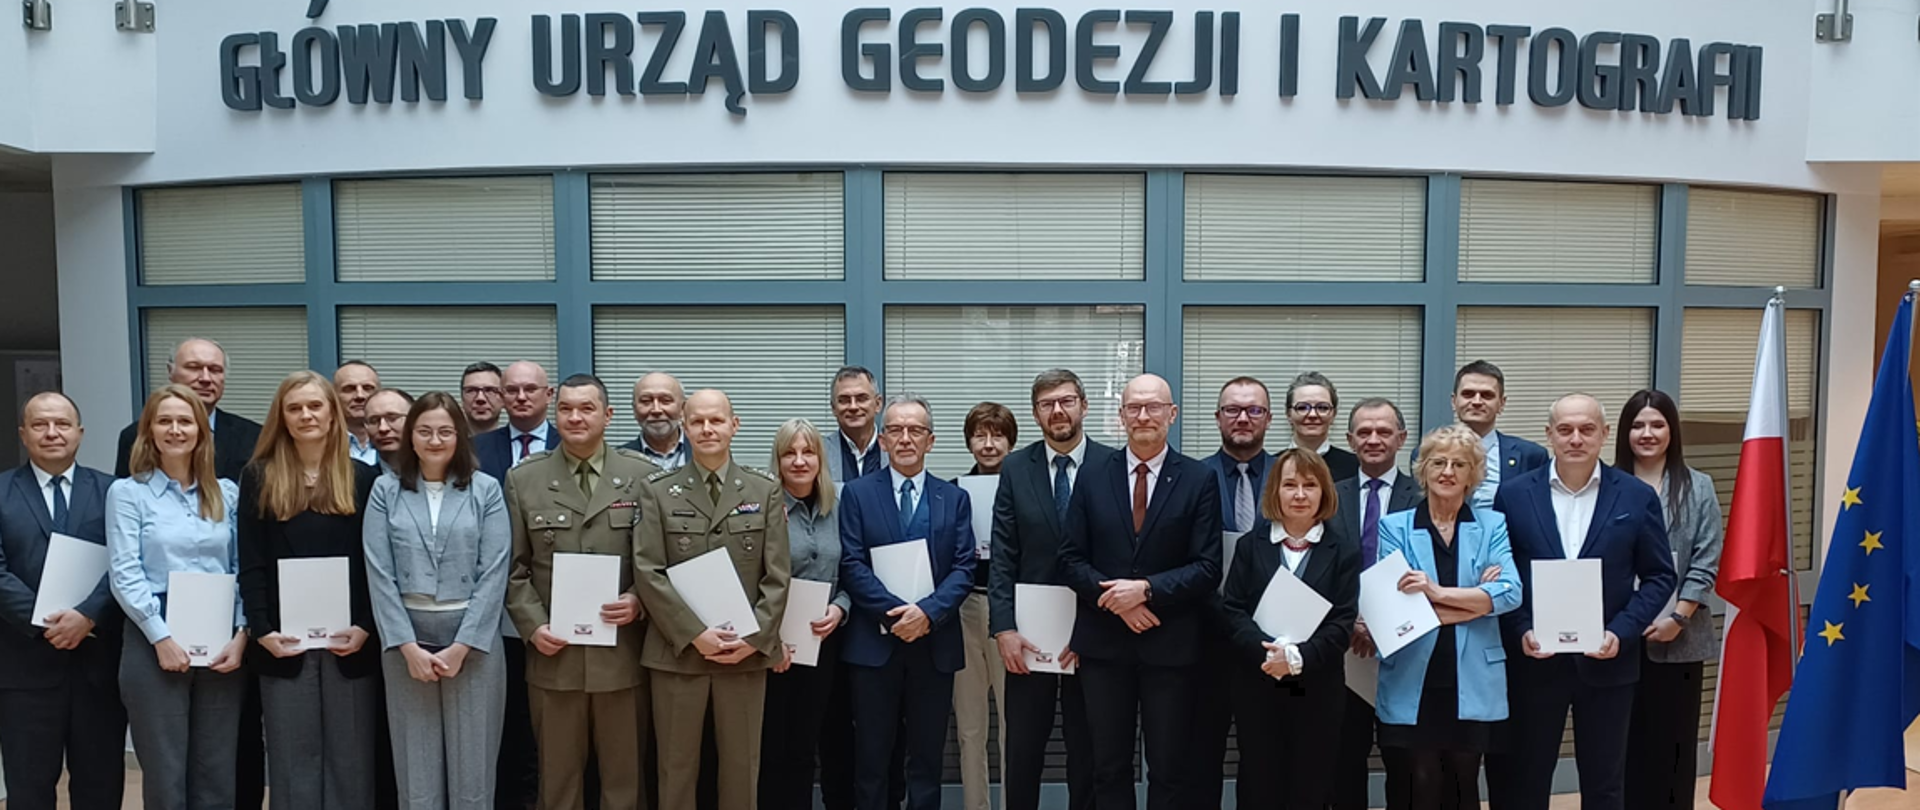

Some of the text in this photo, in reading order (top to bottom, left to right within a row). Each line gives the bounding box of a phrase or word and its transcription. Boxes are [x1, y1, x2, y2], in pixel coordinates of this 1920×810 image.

[220, 0, 1763, 120] GŁÓWNY URZĄD GEODEZJI I KARTOGRAFII
